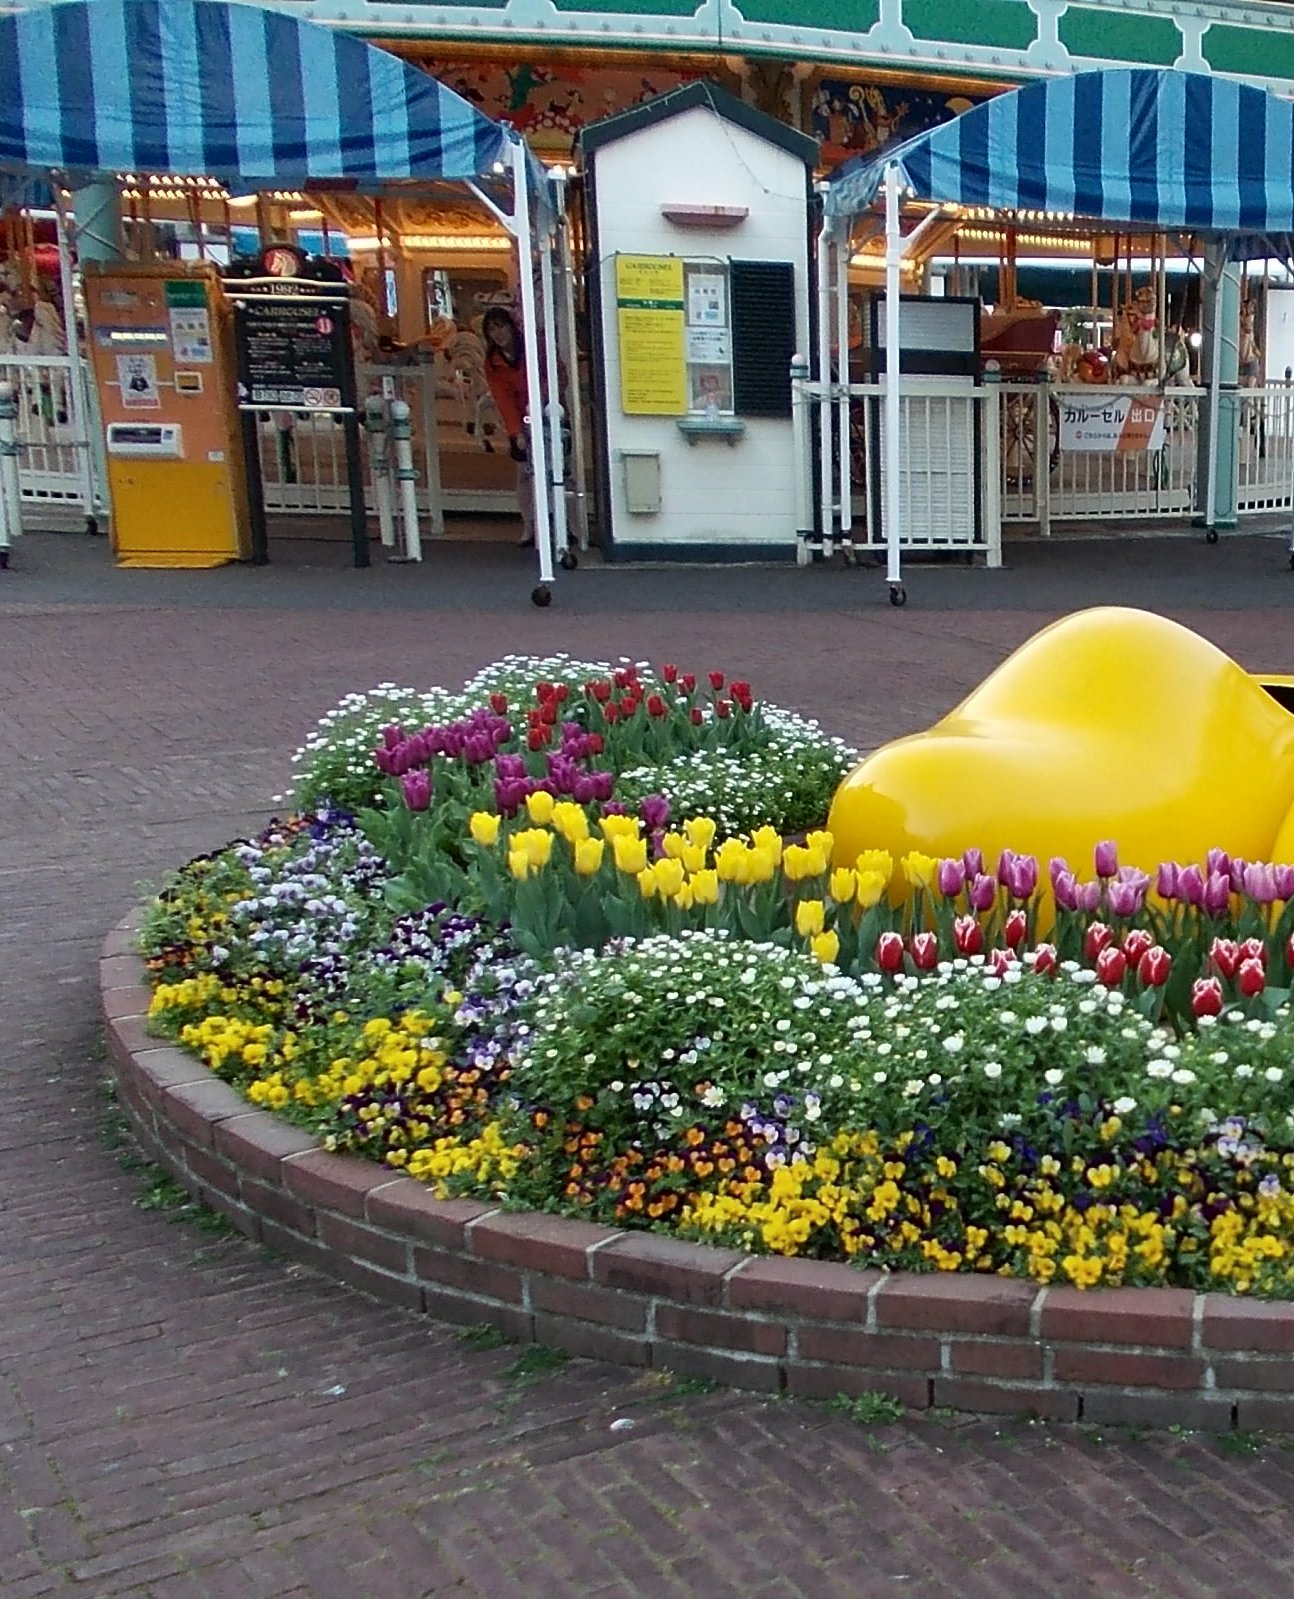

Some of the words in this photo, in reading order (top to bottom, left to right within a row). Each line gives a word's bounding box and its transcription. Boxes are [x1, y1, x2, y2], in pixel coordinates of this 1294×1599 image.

[270, 283, 299, 295] 1992
[254, 306, 319, 317] CARROUSEL
[1064, 408, 1124, 424] カルーセル
[1131, 408, 1155, 423] 出口
